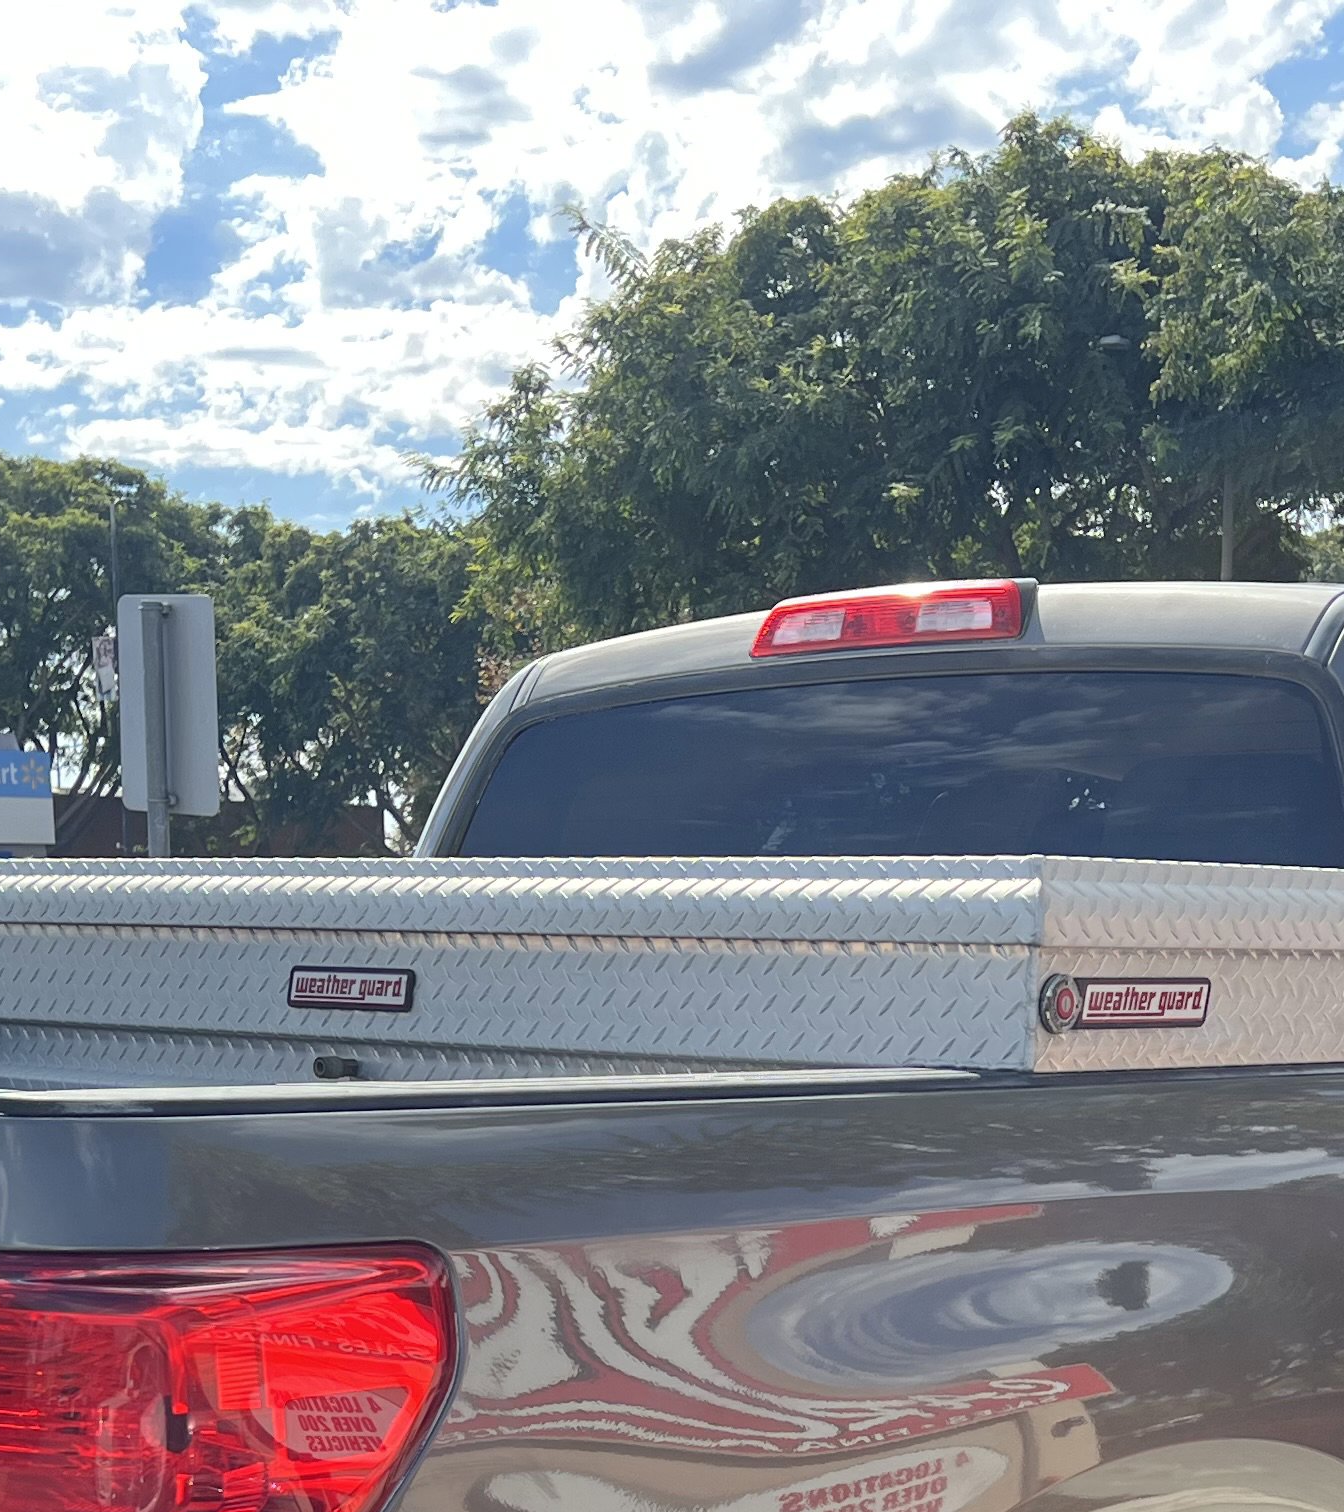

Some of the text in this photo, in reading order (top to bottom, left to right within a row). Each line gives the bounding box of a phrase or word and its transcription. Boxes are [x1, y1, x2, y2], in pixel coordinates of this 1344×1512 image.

[295, 974, 403, 1000] weather guard
[1087, 986, 1204, 1016] weather guard
